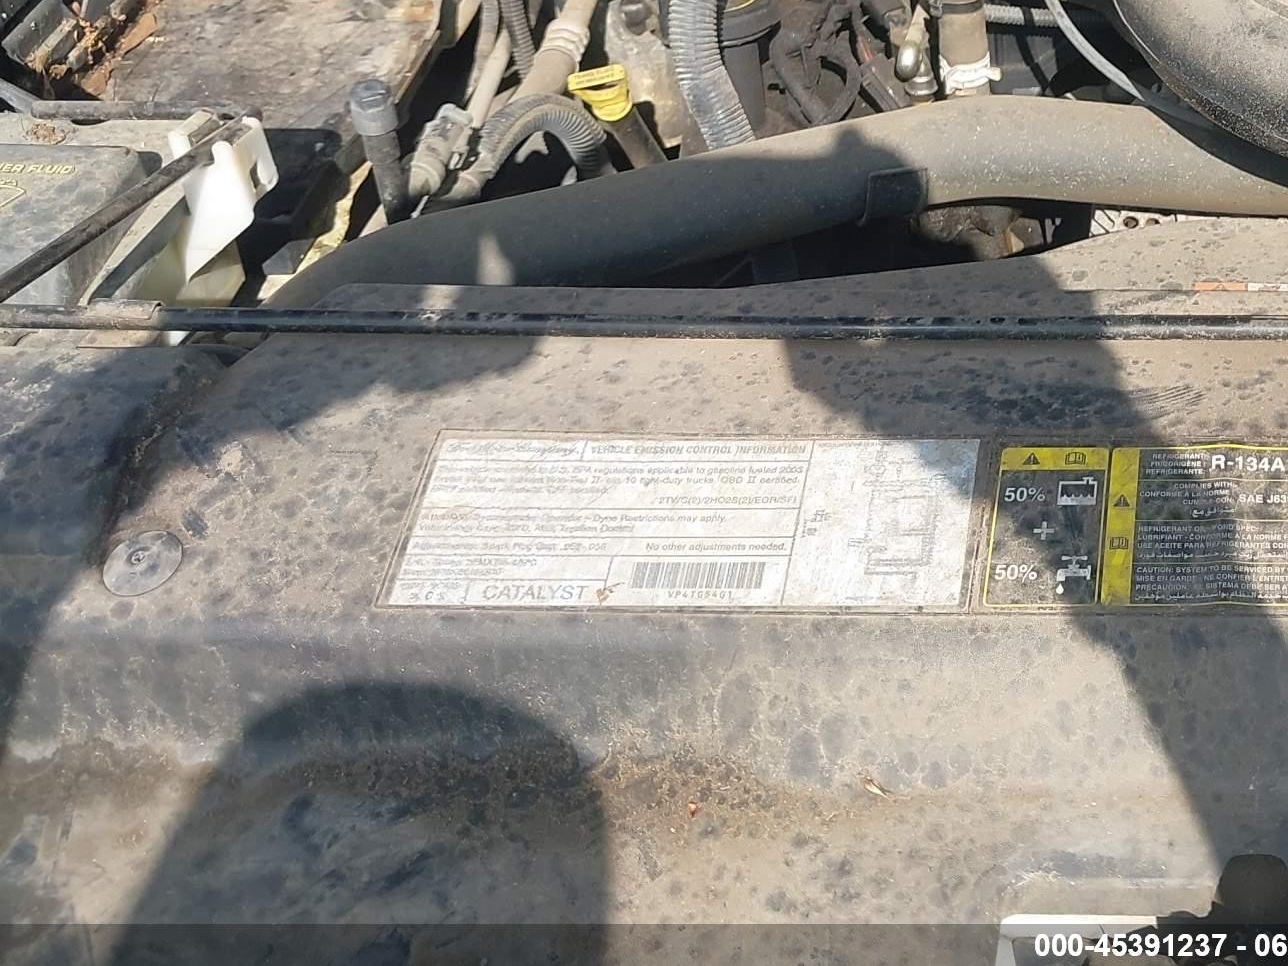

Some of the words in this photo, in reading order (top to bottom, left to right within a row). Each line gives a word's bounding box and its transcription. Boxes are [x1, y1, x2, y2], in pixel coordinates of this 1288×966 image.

[27, 163, 74, 175] FLUID
[634, 445, 684, 455] EMISSION
[686, 445, 732, 455] CONTROL
[735, 445, 806, 455] INFORMATION
[1211, 454, 1286, 472] R-134A
[594, 465, 645, 474] regulations
[696, 465, 705, 474] to
[1004, 487, 1046, 502] 50%
[1238, 494, 1264, 504] SAE
[645, 542, 659, 551] No
[662, 542, 685, 551] other
[688, 542, 747, 551] adjustments
[749, 542, 787, 551] needed.
[994, 564, 1038, 583] 50%
[1234, 565, 1272, 573] SERVICED
[482, 584, 589, 601] CATALYST
